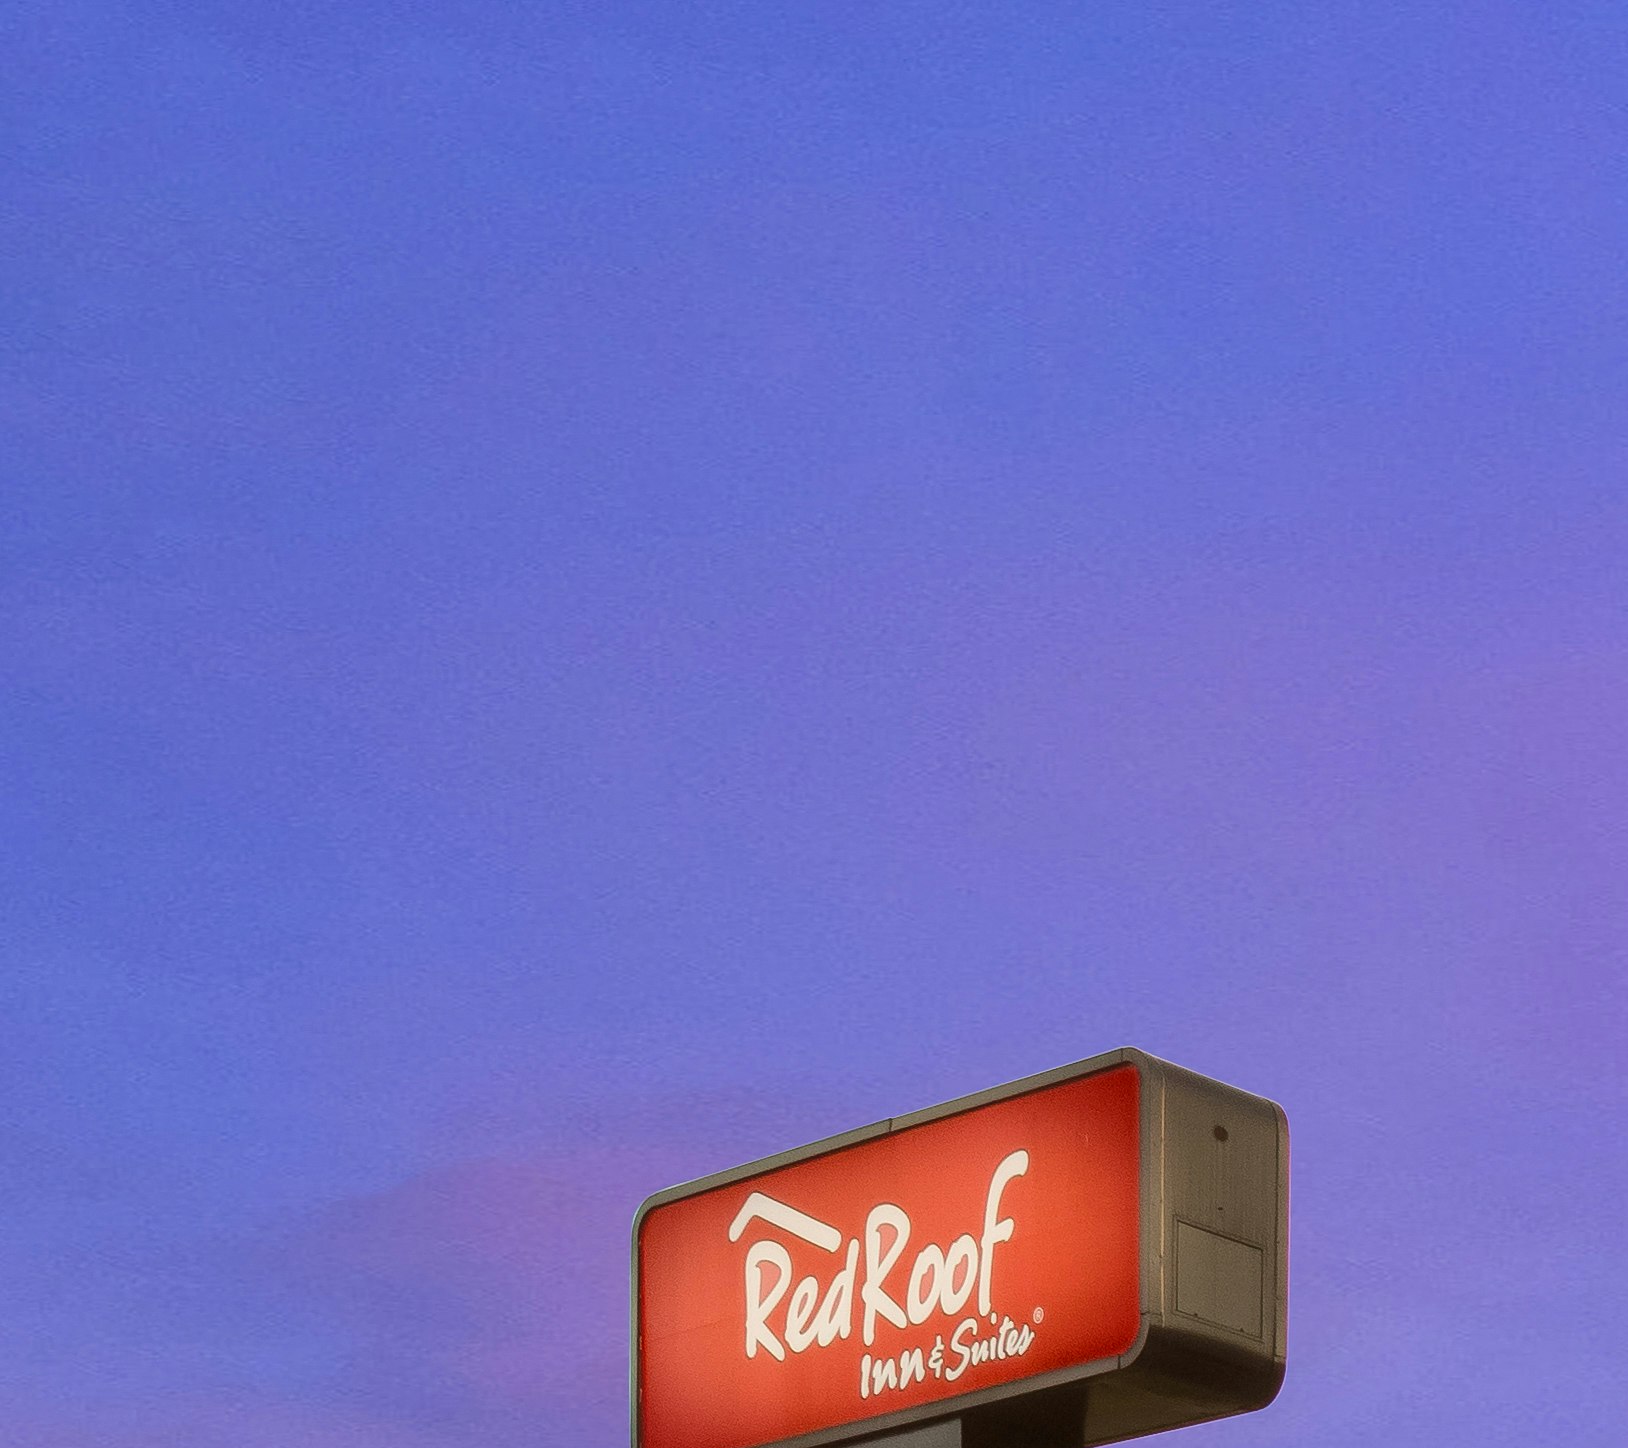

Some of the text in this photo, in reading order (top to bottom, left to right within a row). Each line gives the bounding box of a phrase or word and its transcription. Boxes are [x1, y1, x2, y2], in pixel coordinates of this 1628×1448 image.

[861, 1311, 1036, 1400] Inn & Suites
